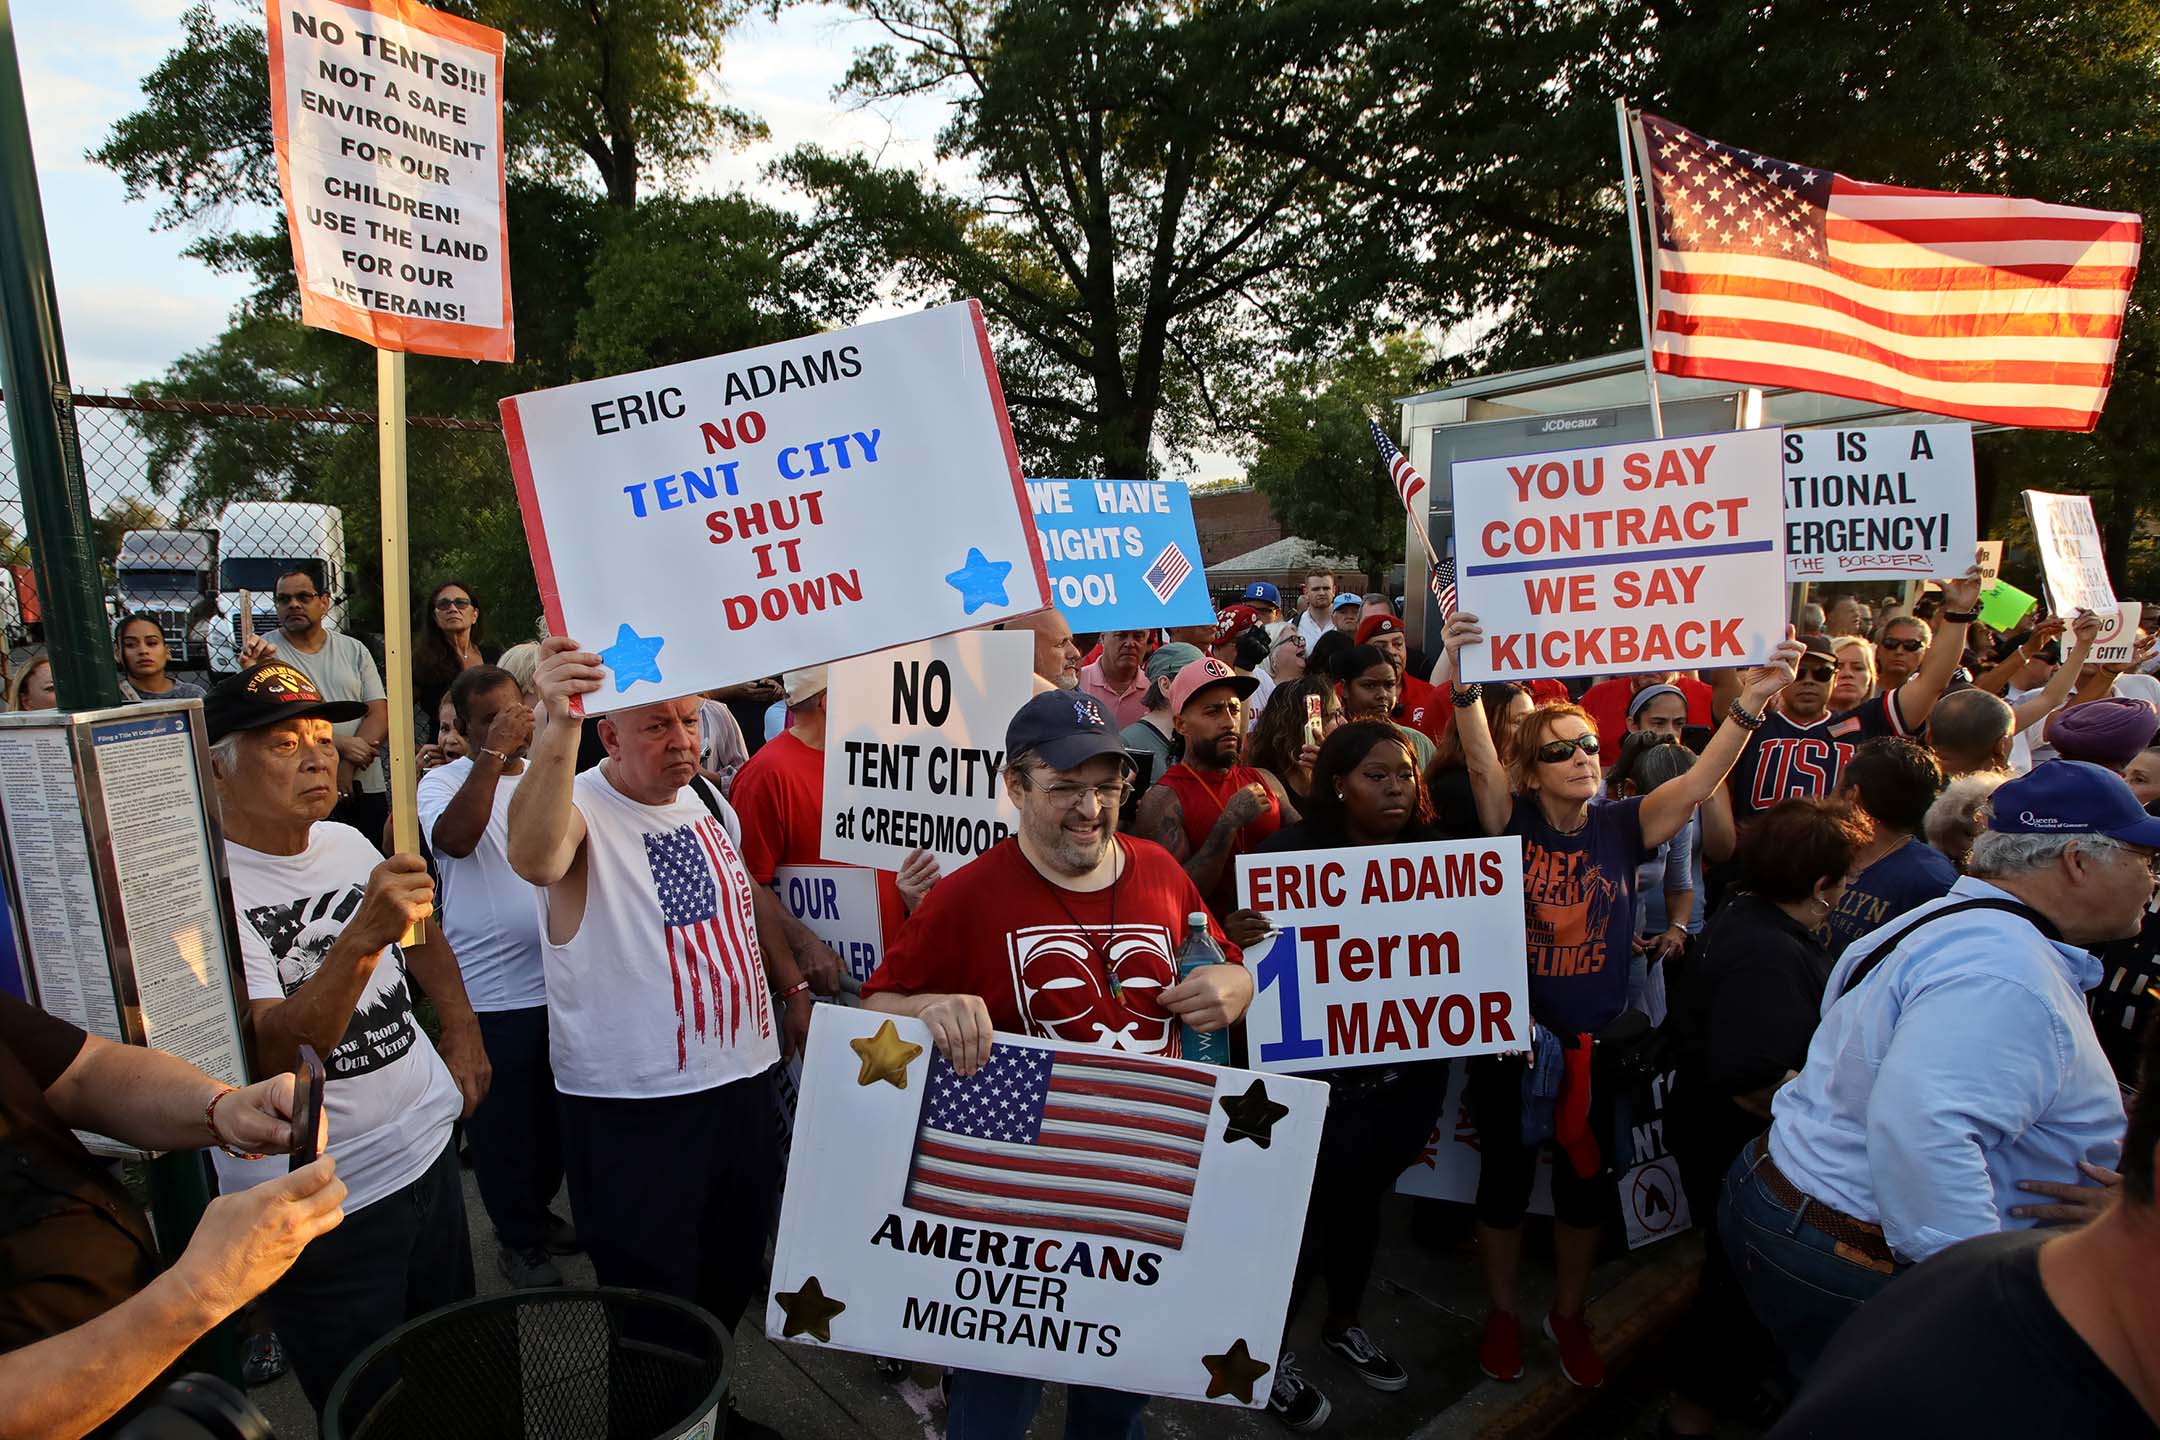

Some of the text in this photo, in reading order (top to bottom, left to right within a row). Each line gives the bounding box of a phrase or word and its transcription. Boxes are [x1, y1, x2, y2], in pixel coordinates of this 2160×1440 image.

[292, 11, 486, 96] NO TENTS!!!
[319, 60, 466, 125] NOT A SAFE
[301, 89, 486, 161] ENVIRONMENT
[341, 137, 450, 186] FOR OUR
[324, 177, 460, 225] CHILDREN!
[306, 205, 488, 262] USE THE LAND
[342, 250, 454, 289] FOR OUR
[332, 277, 466, 322] VETERANS!
[591, 345, 862, 436] ERIC ADAMS
[699, 410, 766, 454] NO
[1542, 418, 1598, 432] JCDecaux
[1837, 432, 1867, 462] IS
[1910, 430, 1933, 460] A
[624, 428, 881, 517] TENT CITY
[1506, 445, 1716, 502] YOU SAY
[1784, 472, 1916, 509] TIONAL
[705, 490, 824, 544] SHUT
[1026, 482, 1170, 515] WE HAVE
[1481, 497, 1749, 558] CONTRACT
[1786, 513, 1949, 555] ERGENCY!
[752, 537, 802, 579] IT
[1790, 554, 1933, 571] THE BORDER!
[722, 568, 863, 630] DOWN
[1524, 565, 1705, 616] WE SAY
[1490, 618, 1745, 672] KICKBACK
[2096, 647, 2128, 659] CITY!
[891, 659, 951, 727] NO
[844, 741, 1004, 800] TENT CITY
[835, 806, 1008, 856] at CREEDMOOR
[2020, 811, 2058, 826] Queens
[789, 877, 840, 921] OUR
[1248, 851, 1503, 911] ERIC ADAMS
[1834, 889, 1890, 923] LYN
[708, 815, 770, 1040] SAVE OUR CHILDREN
[1256, 924, 1461, 1062] 1 Term
[363, 1022, 399, 1046] PROUD
[1327, 991, 1515, 1056] MAYOR
[335, 1055, 370, 1072] OUR
[871, 1214, 1163, 1287] AMERICANS
[955, 1267, 1068, 1313] OVER
[902, 1297, 1122, 1358] MIGRANTS
